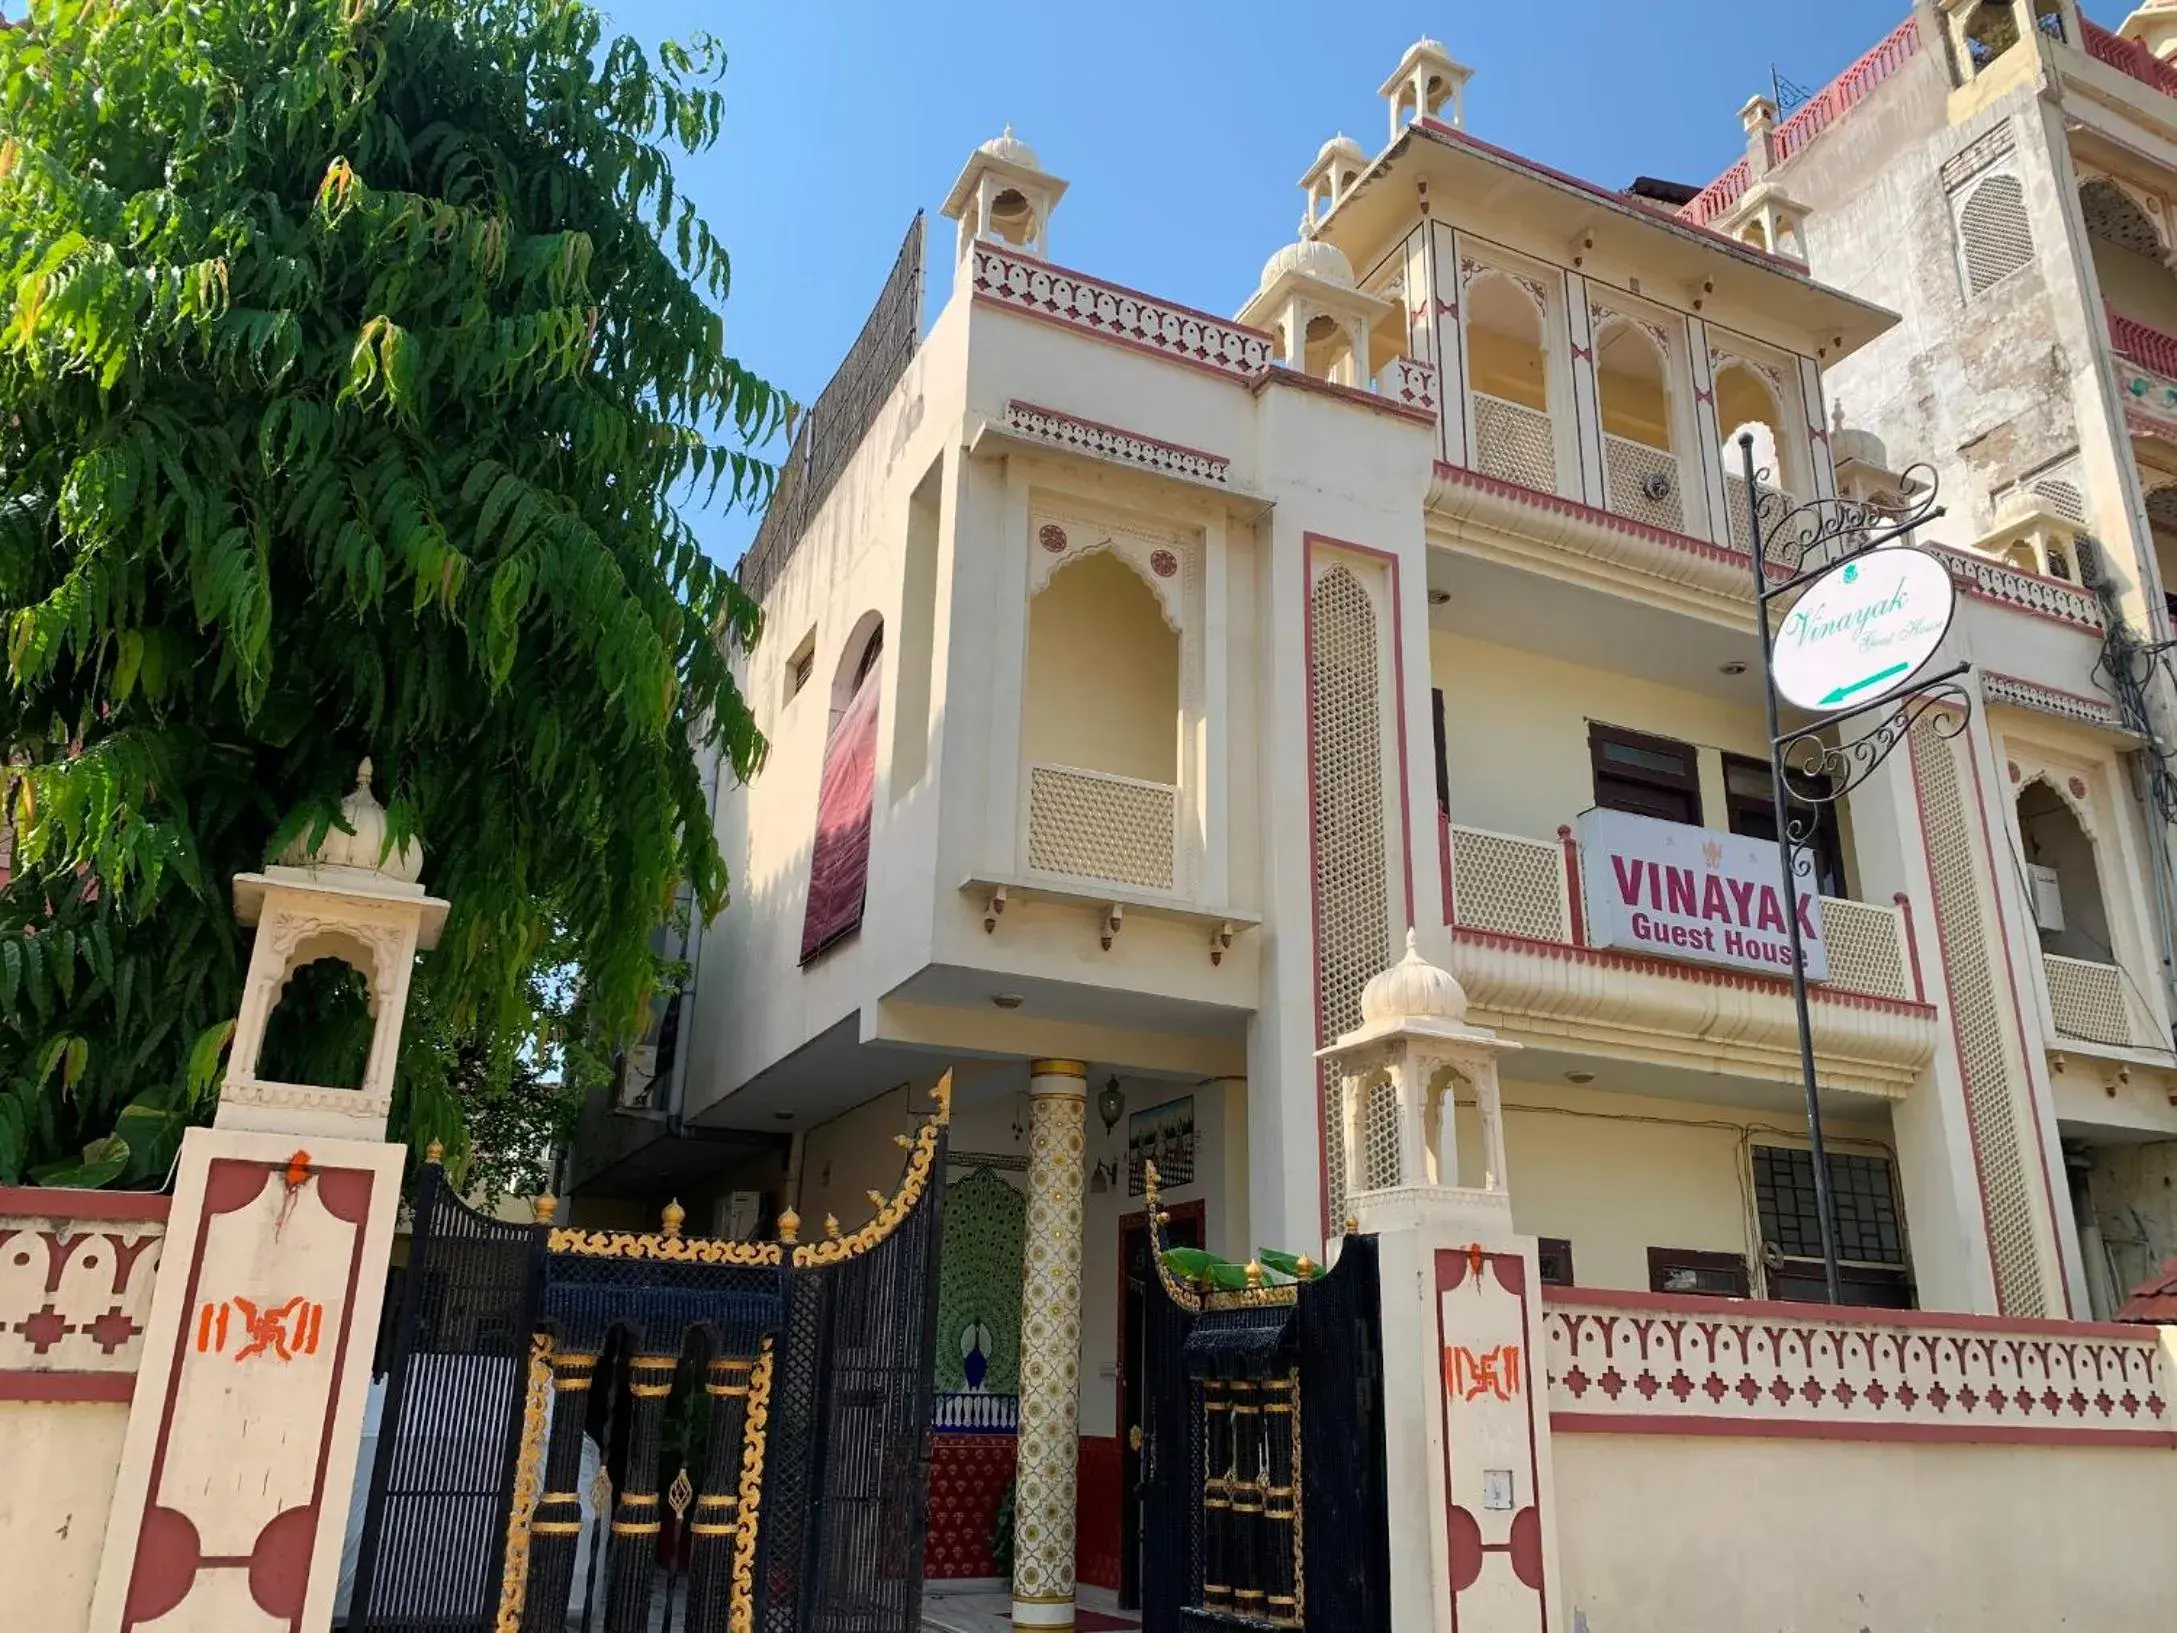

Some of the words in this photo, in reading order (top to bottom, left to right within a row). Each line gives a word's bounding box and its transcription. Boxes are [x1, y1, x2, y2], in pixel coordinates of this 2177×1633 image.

[1786, 576, 1909, 646] Vinayak
[1611, 855, 1818, 941] VINAYAK
[1631, 912, 1716, 952] Guest
